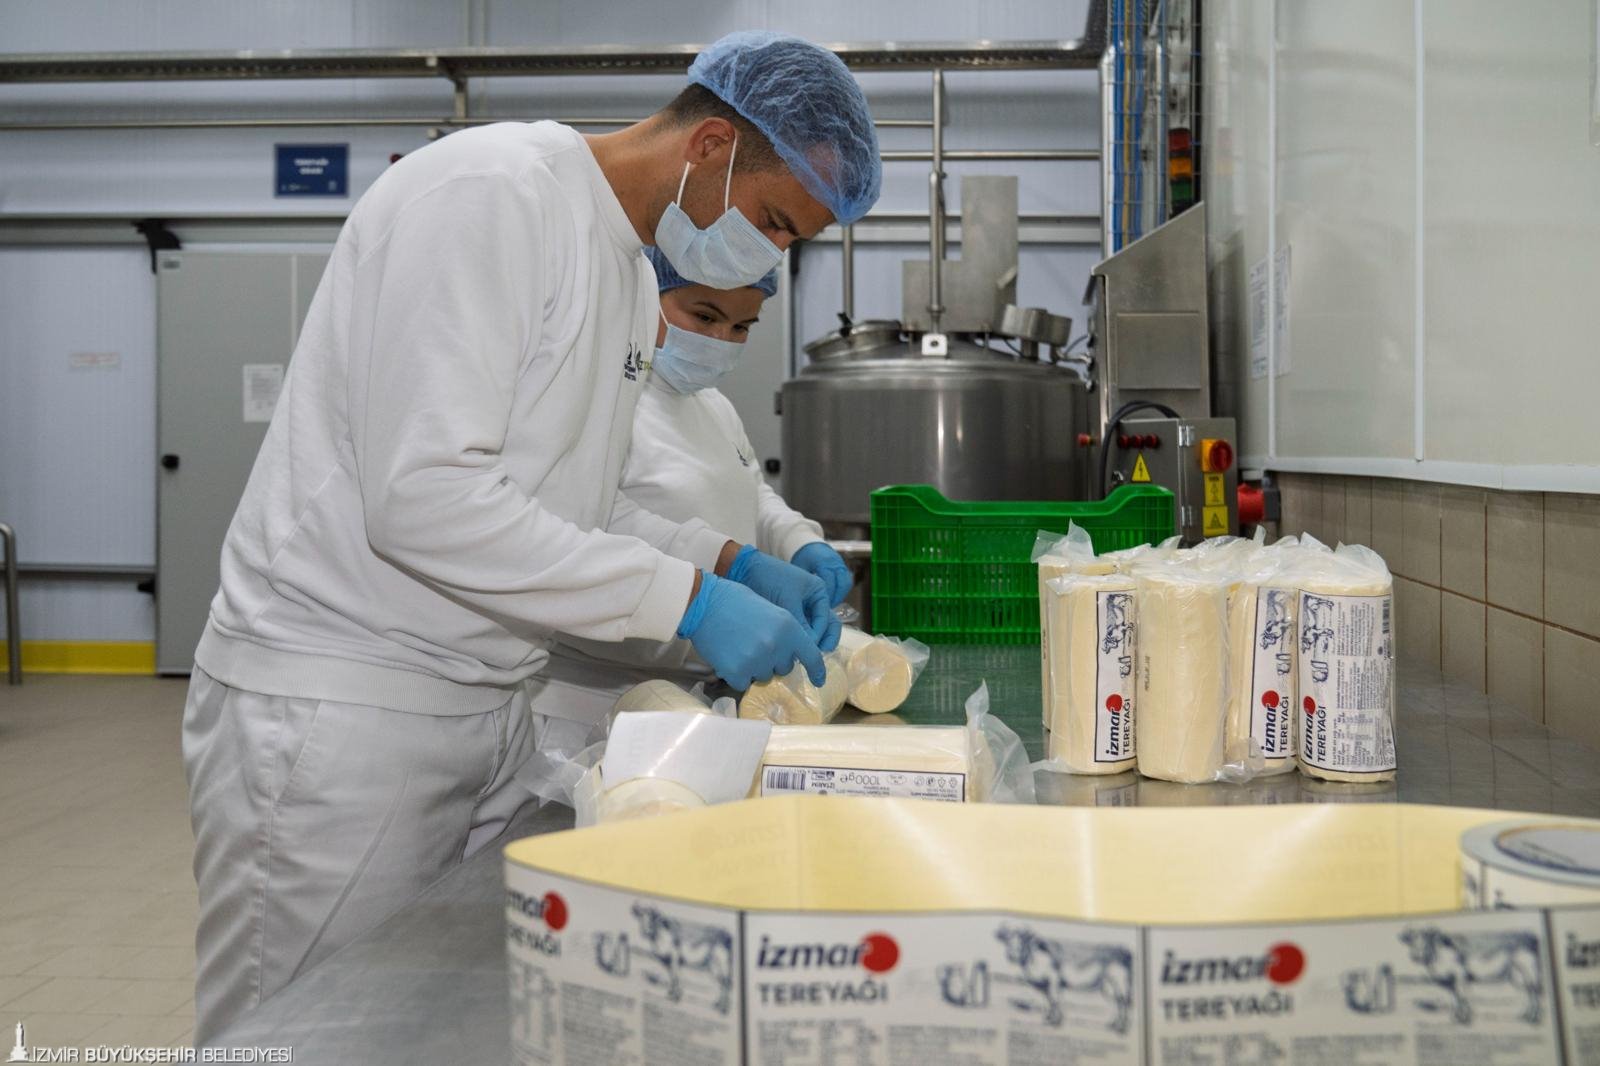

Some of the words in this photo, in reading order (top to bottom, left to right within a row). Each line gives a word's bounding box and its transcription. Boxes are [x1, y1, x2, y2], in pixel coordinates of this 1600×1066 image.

[1280, 695, 1290, 753] TEREYAĞI
[1316, 704, 1328, 763] TEREYAĞI
[759, 976, 889, 1006] TEREYAĞI
[1163, 990, 1293, 1021] TEREYAĞI
